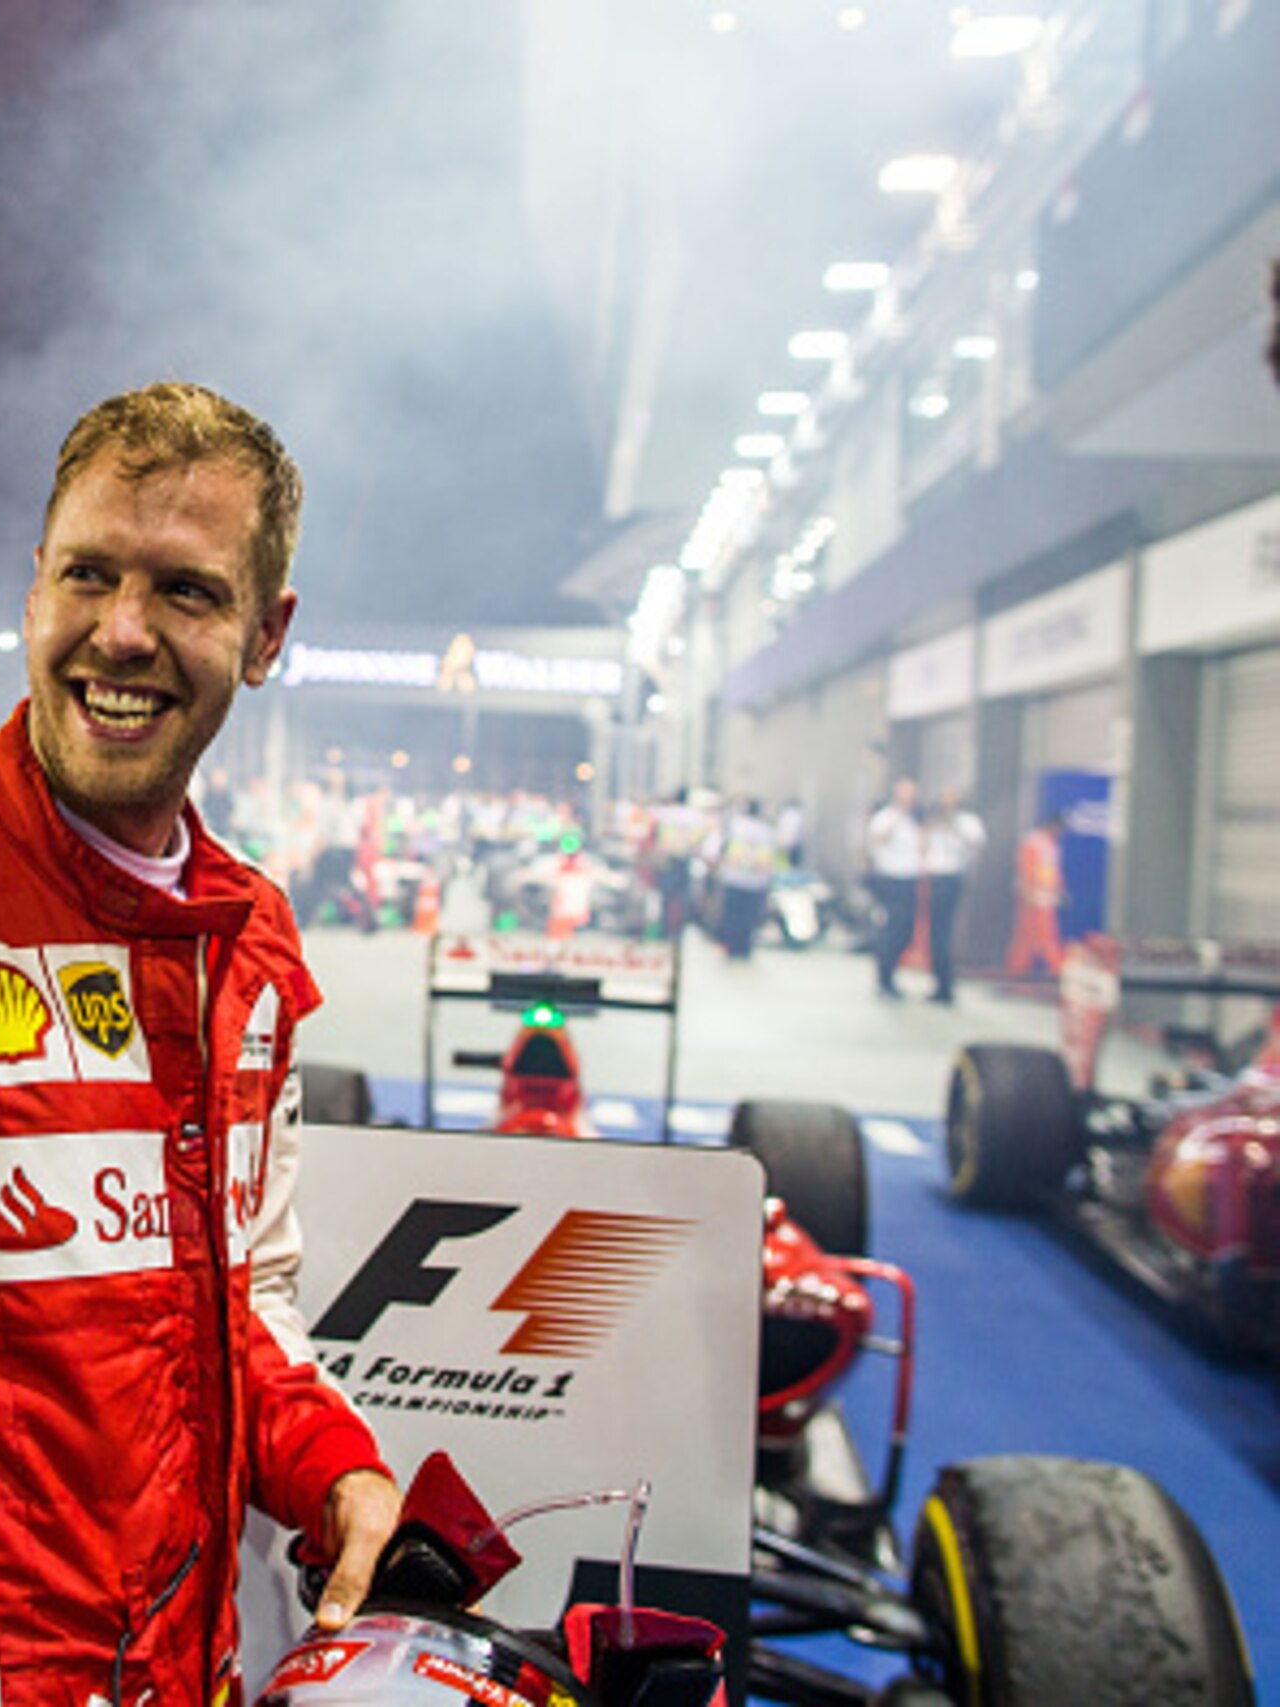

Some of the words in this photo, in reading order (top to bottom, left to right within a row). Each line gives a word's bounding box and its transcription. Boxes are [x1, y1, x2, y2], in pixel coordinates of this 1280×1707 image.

[308, 1198, 704, 1358] F1
[363, 1356, 539, 1394] Formula
[542, 1370, 574, 1398] 1
